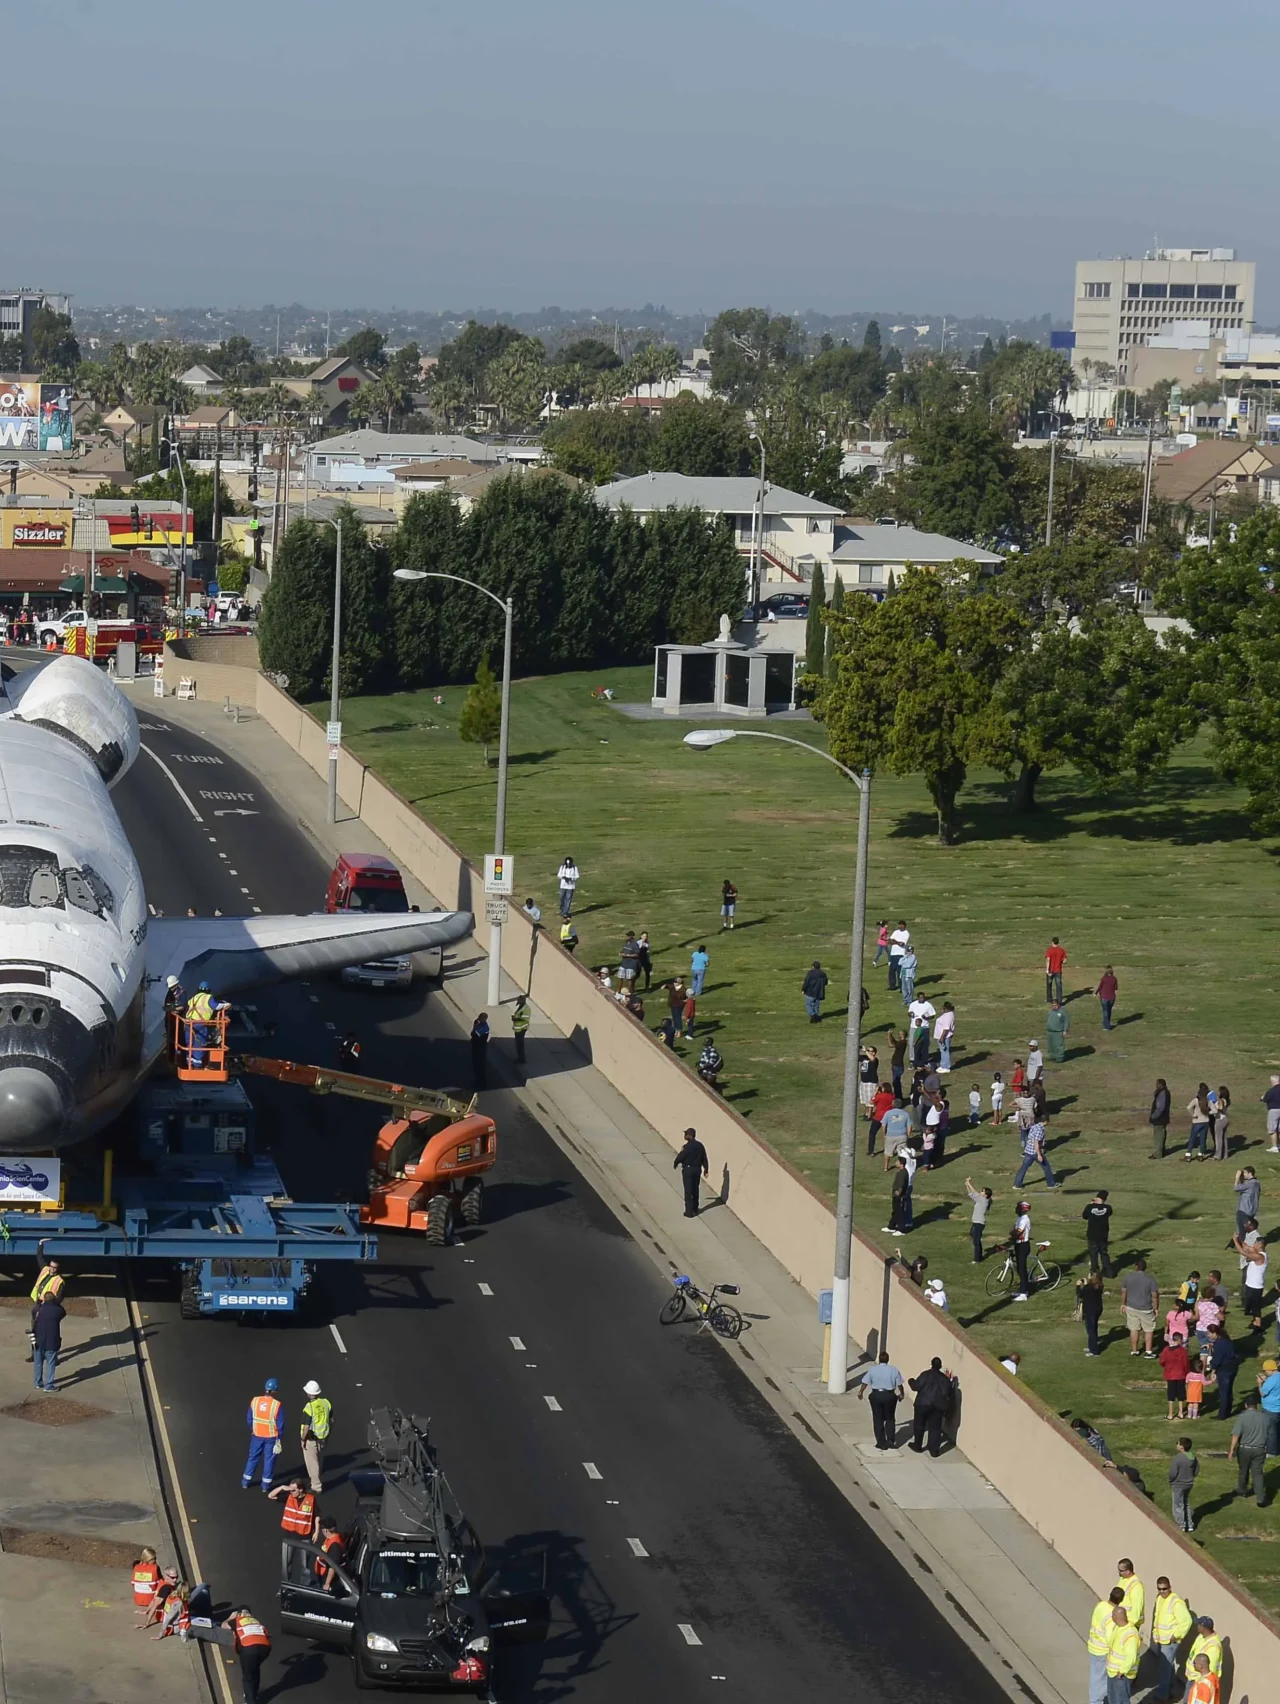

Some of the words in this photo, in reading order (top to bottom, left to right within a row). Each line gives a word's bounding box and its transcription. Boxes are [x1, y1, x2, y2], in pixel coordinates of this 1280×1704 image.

[14, 528, 64, 541] Sizzler
[138, 723, 172, 731] NLY
[171, 754, 224, 765] TURN
[199, 790, 255, 801] RIGHT
[22, 1192, 35, 1200] Space
[228, 1294, 289, 1305] sarens
